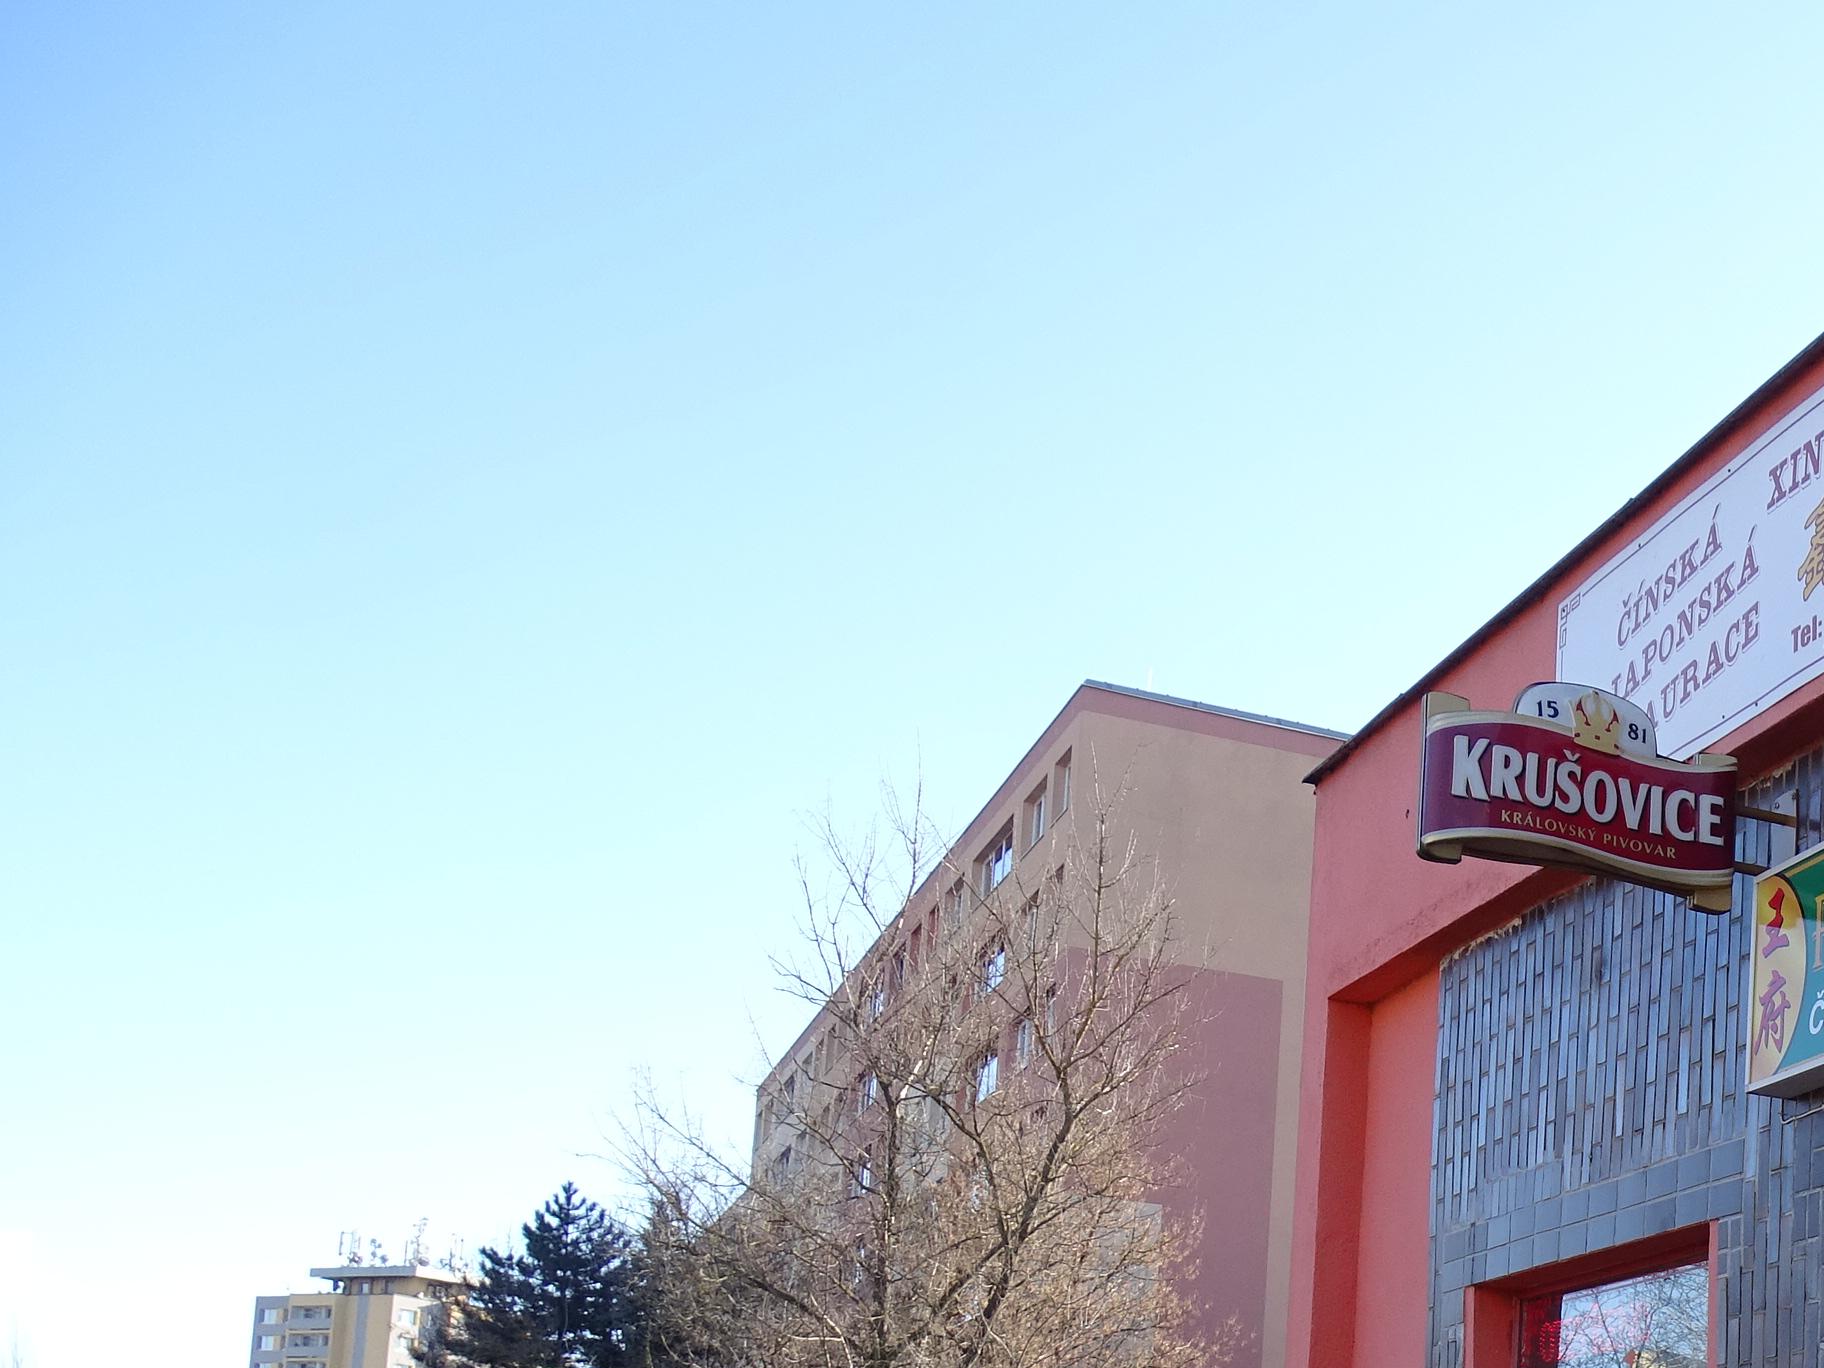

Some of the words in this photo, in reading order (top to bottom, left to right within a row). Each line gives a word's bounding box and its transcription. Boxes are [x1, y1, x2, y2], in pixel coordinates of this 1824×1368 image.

[1766, 430, 1824, 511] XIN
[1617, 503, 1723, 648] ČÍNSKÁ
[1645, 601, 1759, 730] AURACE
[1791, 615, 1823, 653] Tel:
[1536, 700, 1560, 719] 15
[1627, 722, 1648, 745] 81
[1450, 734, 1725, 847] KRUŠOVICE
[1500, 808, 1597, 842] KRÁLOVSKÝ
[1603, 833, 1677, 860] PIVOVAR
